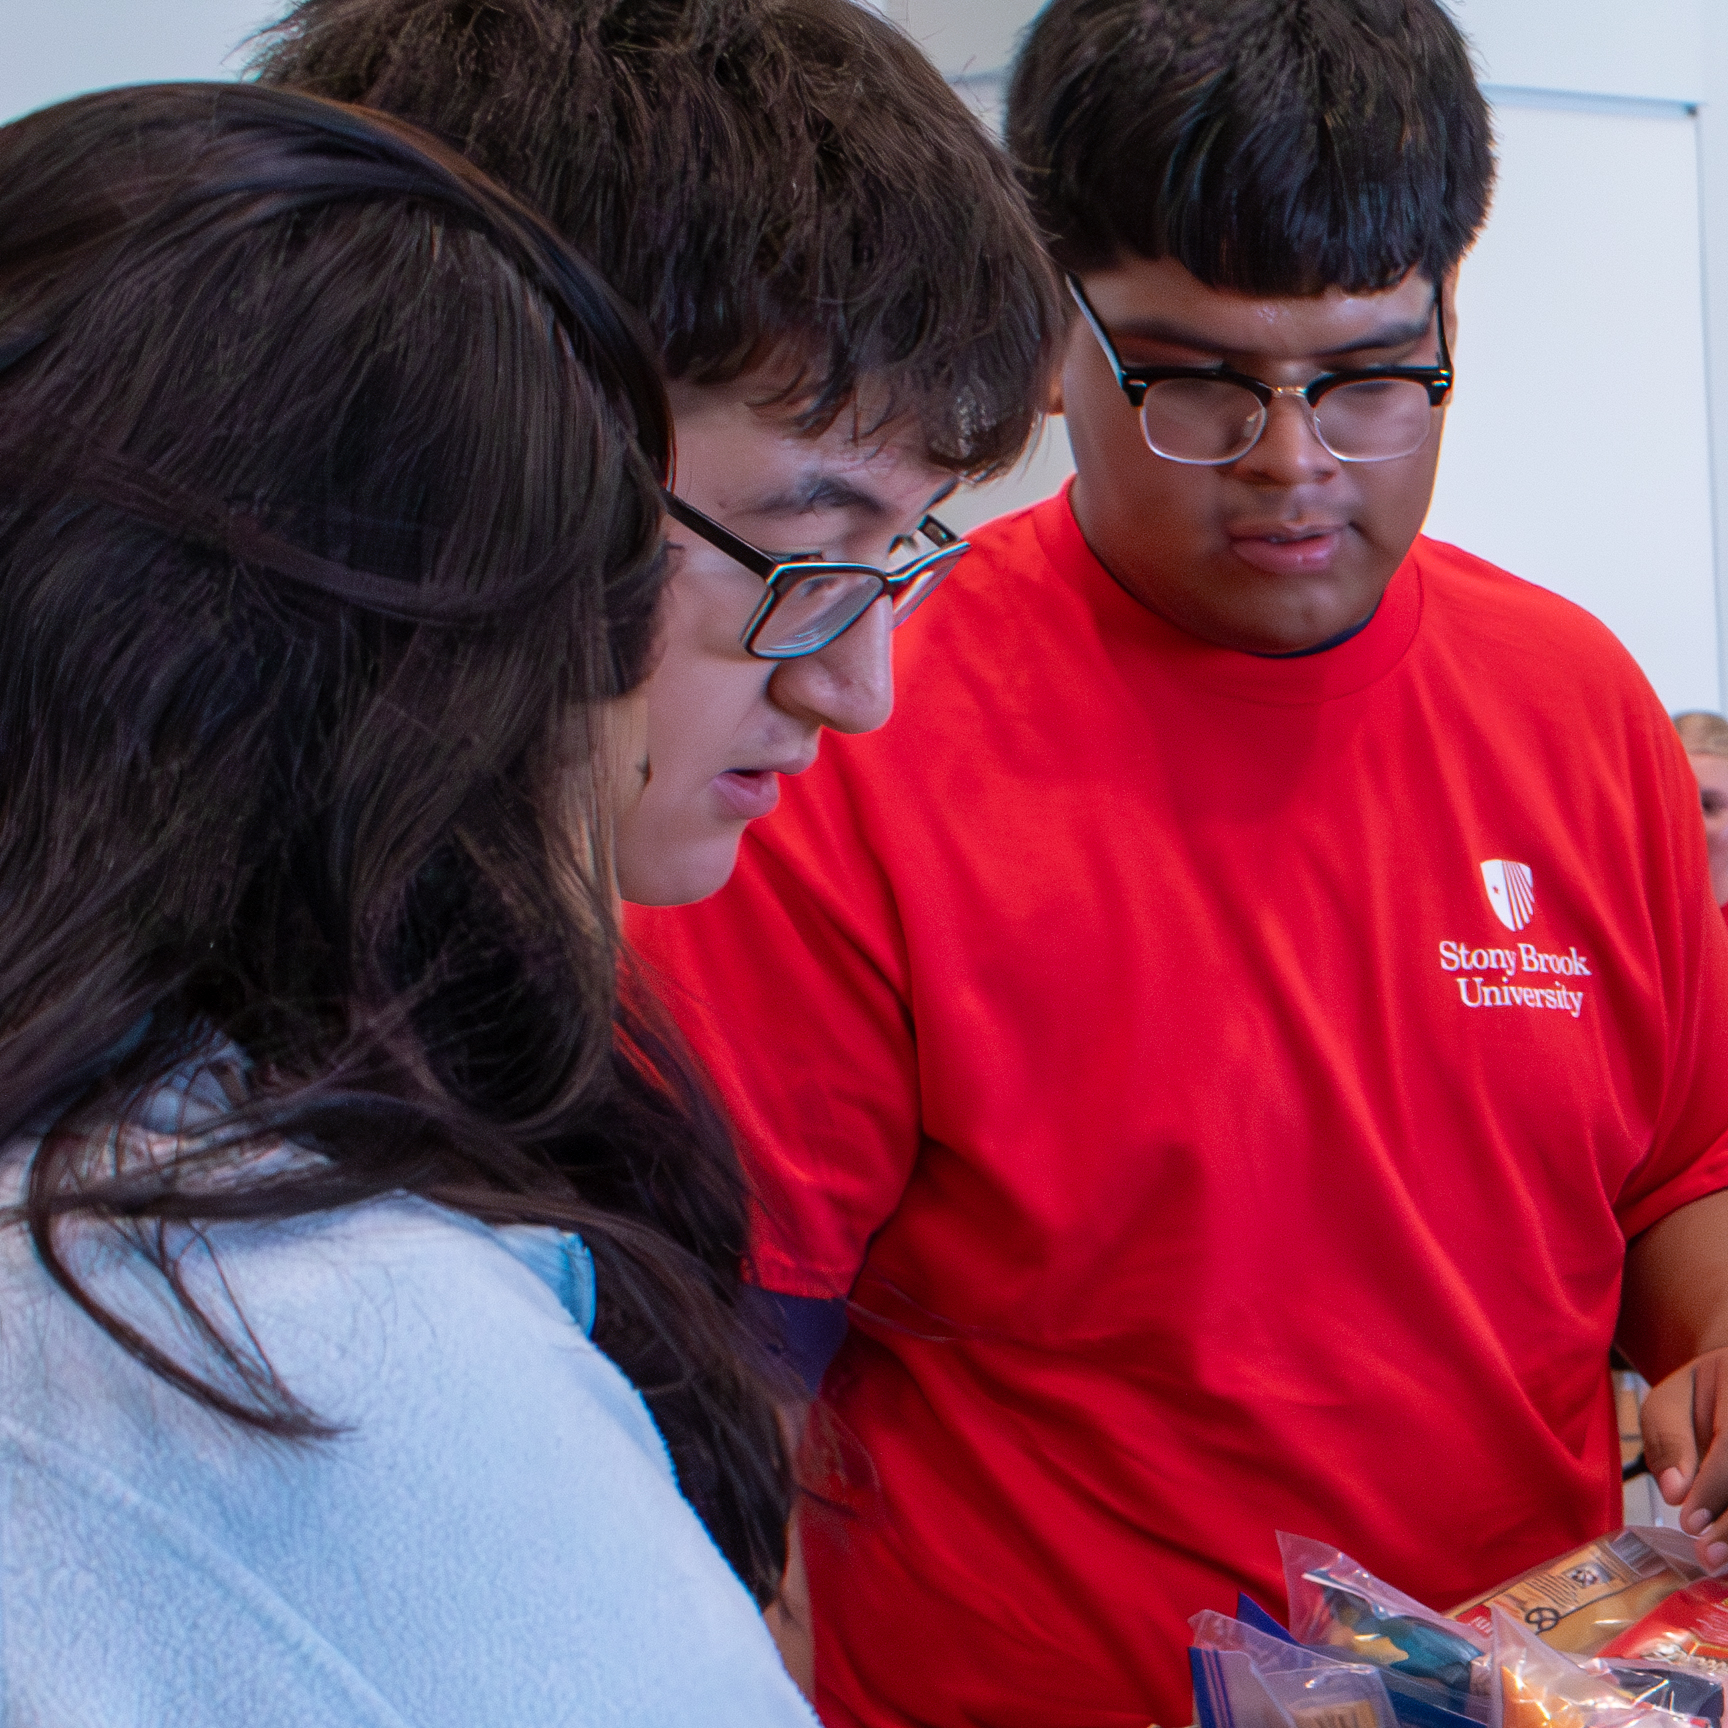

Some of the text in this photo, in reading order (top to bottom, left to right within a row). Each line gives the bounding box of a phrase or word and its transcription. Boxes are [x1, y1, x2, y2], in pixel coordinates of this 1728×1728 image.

[1439, 940, 1592, 976] Stony Brook
[1456, 976, 1583, 1019] University
